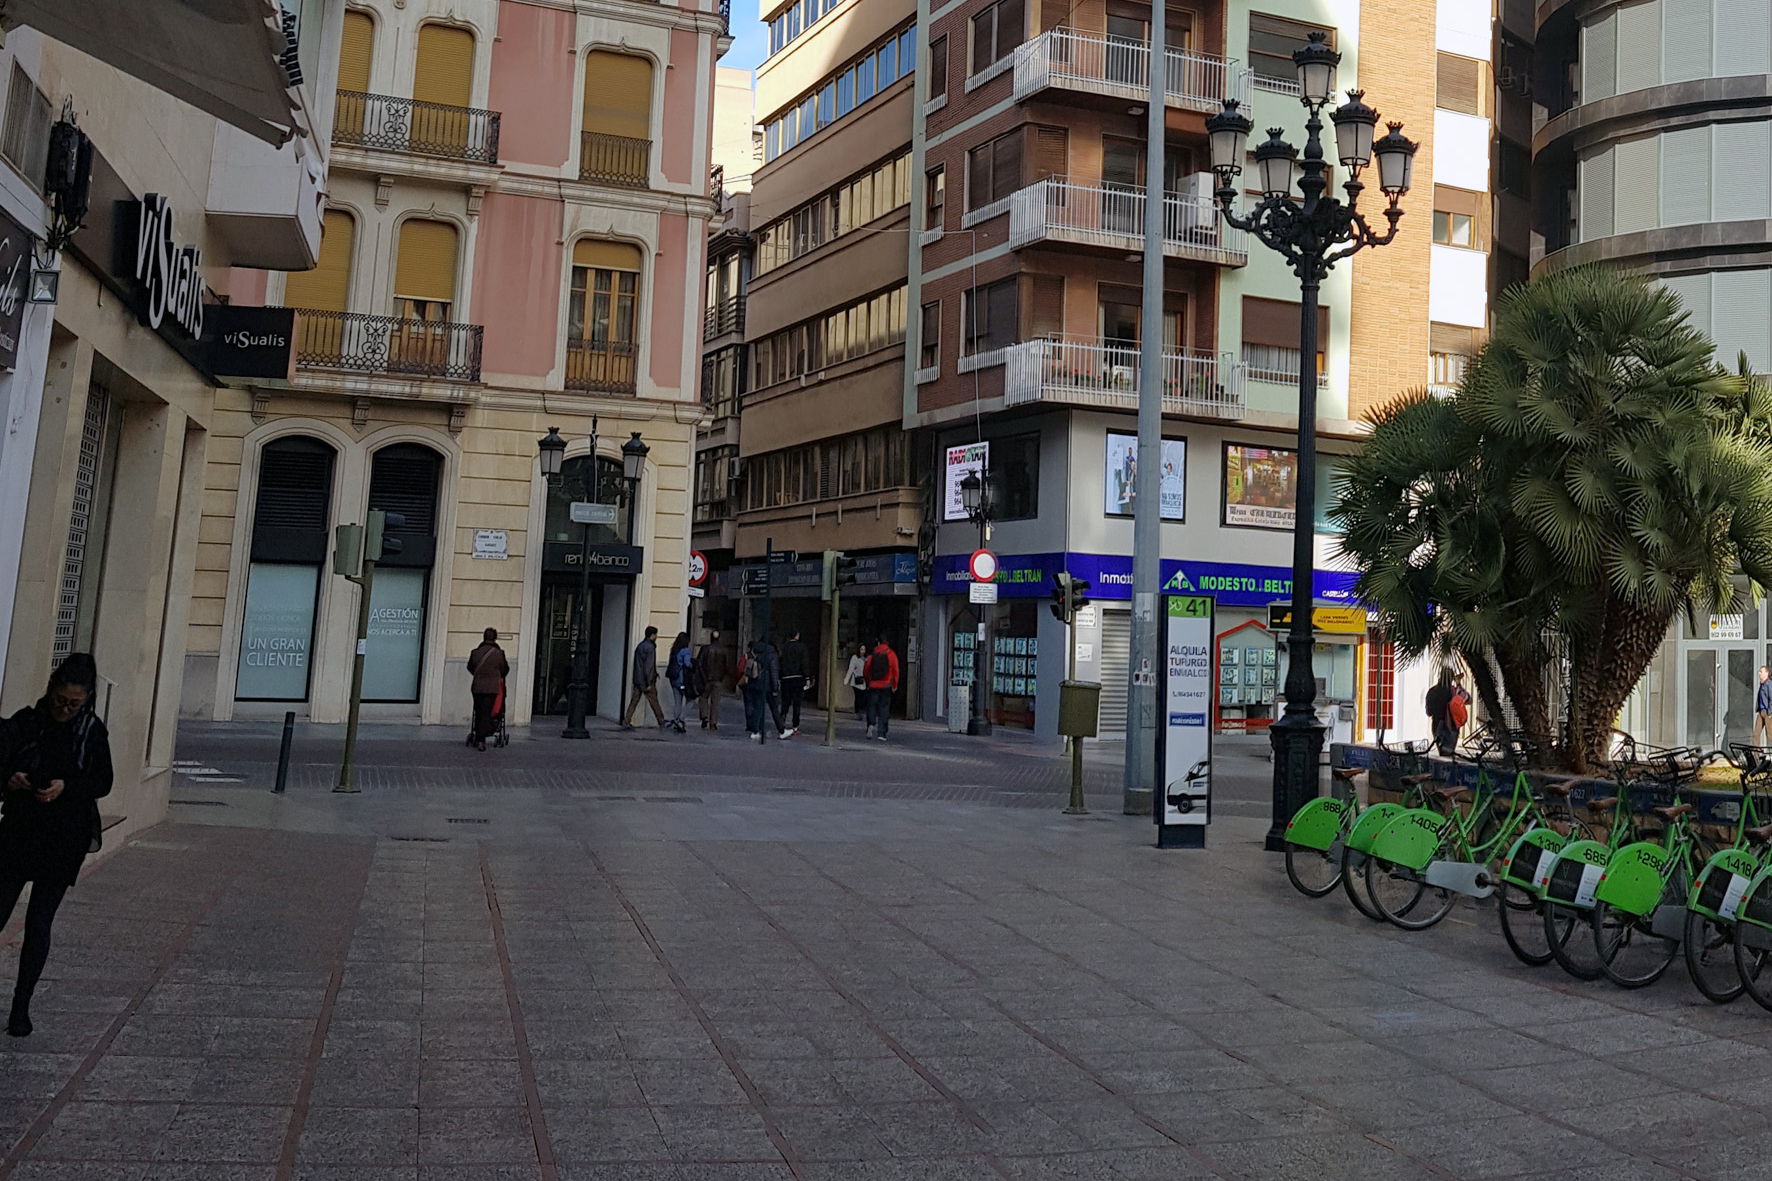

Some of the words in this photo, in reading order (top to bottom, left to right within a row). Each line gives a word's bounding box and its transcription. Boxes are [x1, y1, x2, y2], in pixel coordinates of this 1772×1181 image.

[1200, 576, 1255, 592] MODESTO
[1186, 599, 1207, 616] 41
[248, 638, 267, 650] UN
[270, 638, 305, 651] GRAN
[246, 652, 303, 667] CLIENTE
[1323, 801, 1341, 814] 868
